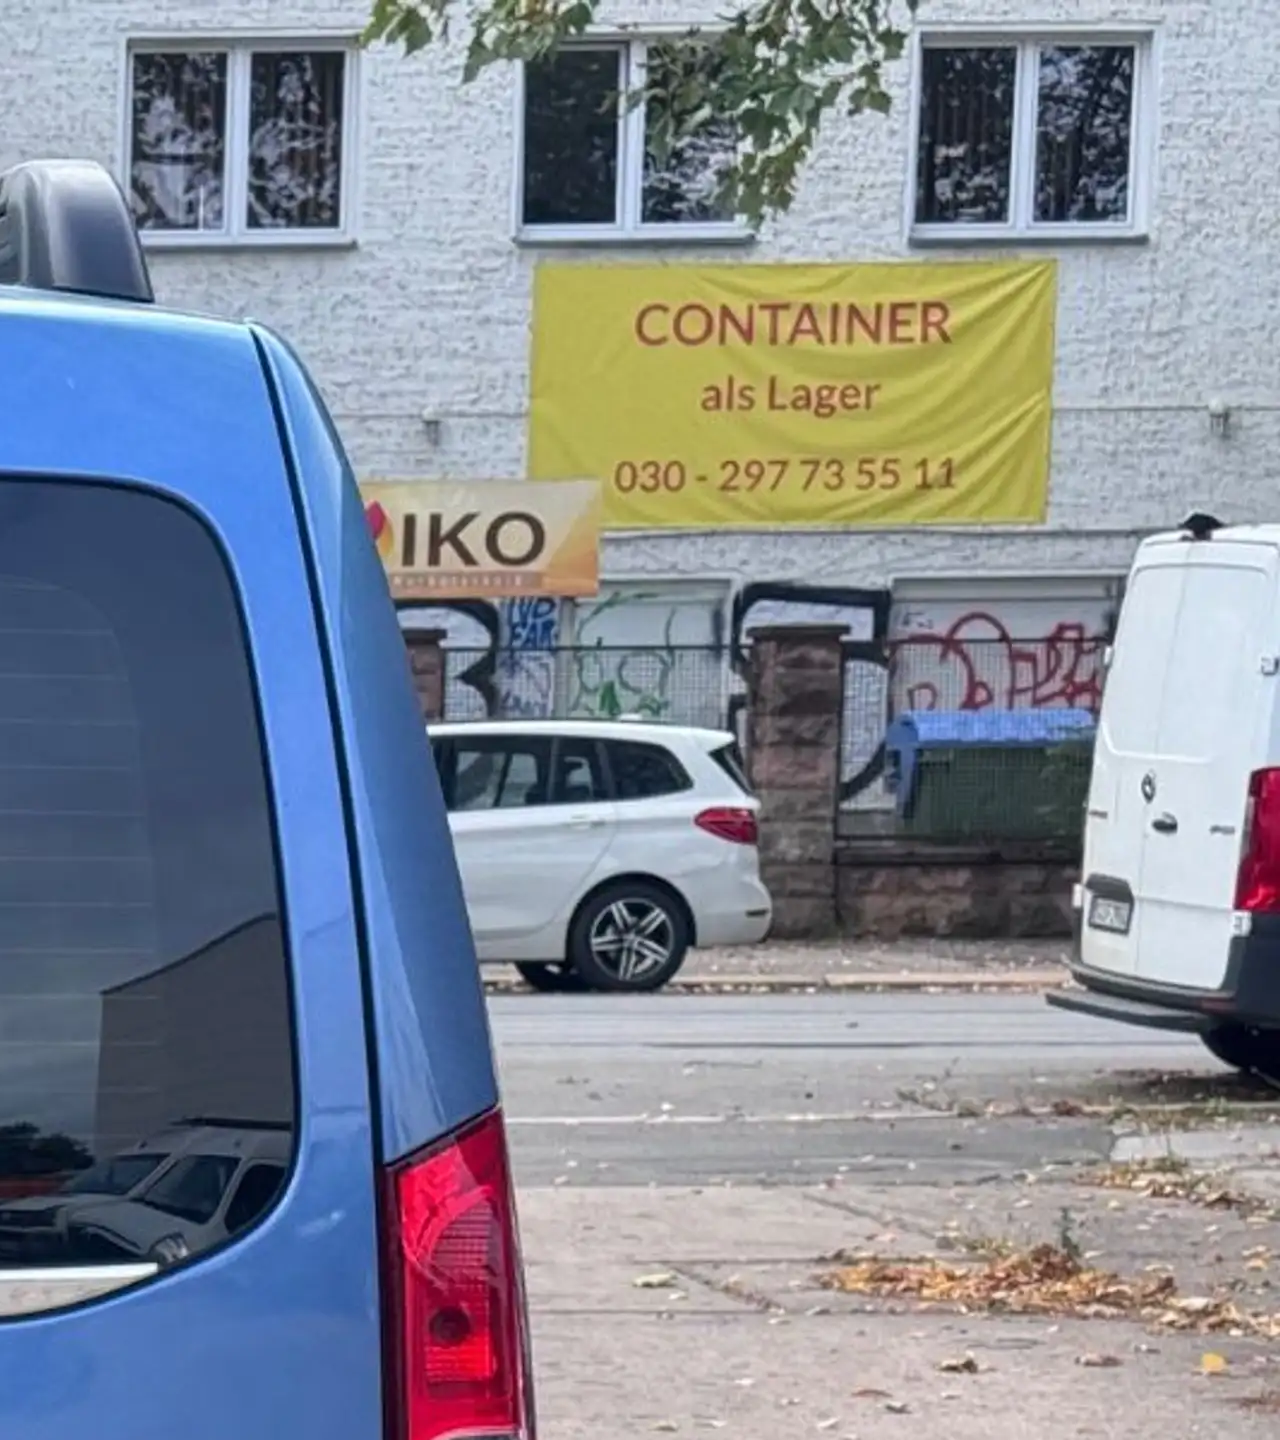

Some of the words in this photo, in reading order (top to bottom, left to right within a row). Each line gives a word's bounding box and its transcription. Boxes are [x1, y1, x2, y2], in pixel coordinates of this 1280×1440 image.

[634, 301, 953, 346] CONTAINER
[701, 375, 755, 411] als
[768, 376, 881, 418] Lager
[614, 460, 685, 493] 030
[719, 460, 789, 492] 297
[799, 458, 845, 491] 73
[856, 458, 900, 490] 55
[914, 457, 955, 490] 11
[401, 511, 546, 567] IKO
